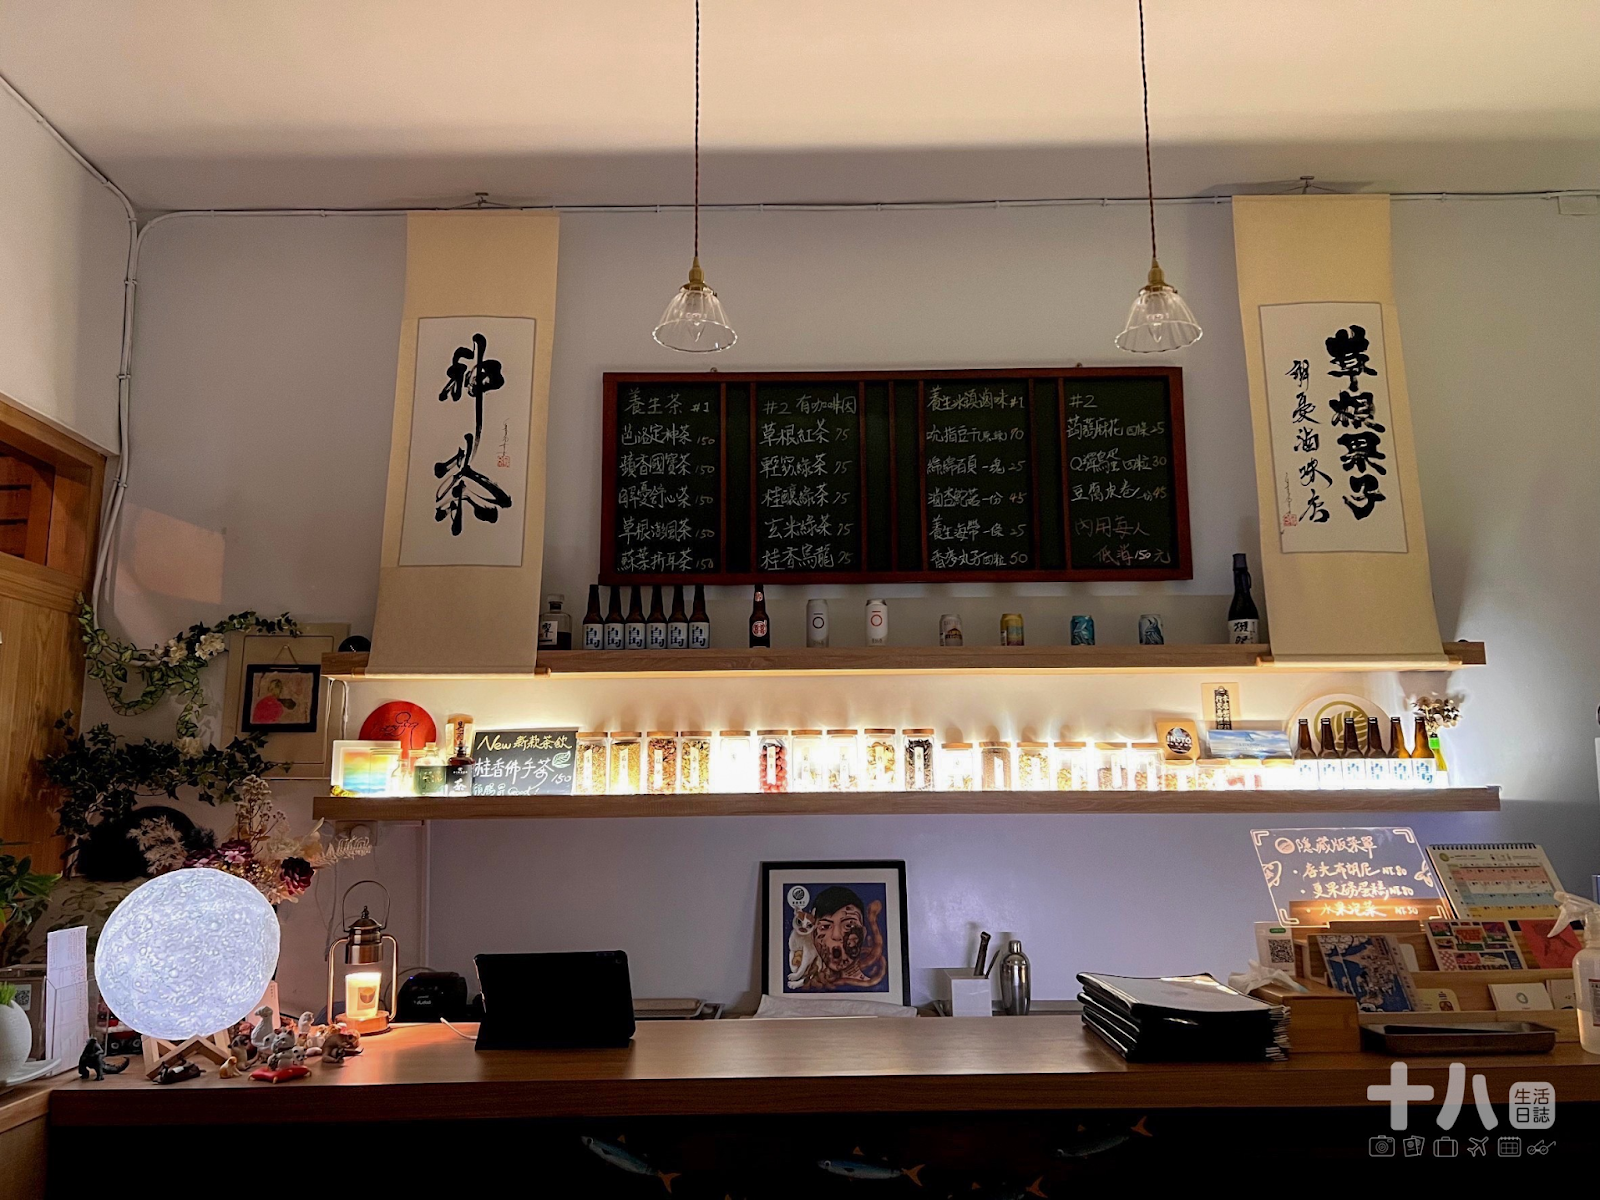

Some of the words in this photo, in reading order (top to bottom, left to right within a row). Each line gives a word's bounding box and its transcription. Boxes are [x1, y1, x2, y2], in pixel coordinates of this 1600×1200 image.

[624, 387, 682, 415] 養生茶
[690, 401, 710, 413] #1
[762, 400, 792, 415] #2
[796, 392, 857, 415] 有咖啡因
[1069, 393, 1098, 408] #2
[1325, 325, 1387, 521] 草根果子
[434, 333, 513, 536] 神茶
[759, 418, 830, 447] 草根紅茶
[835, 428, 850, 441] 75
[697, 436, 716, 446] 150
[619, 450, 691, 478] 蘋香國寶茶
[695, 465, 715, 475] 150
[833, 460, 853, 474] 75
[1008, 460, 1026, 472] 25
[1152, 455, 1167, 467] 30
[619, 480, 691, 509] 解憂舒心茶
[695, 495, 714, 506] 150
[832, 491, 850, 505] 75
[1009, 491, 1028, 504] 45
[1152, 486, 1167, 499] 45
[764, 513, 832, 539] 玄米綠茶
[837, 523, 855, 536] 75
[1010, 524, 1027, 538] 25
[695, 529, 715, 539] 150
[696, 558, 714, 570] 150
[760, 543, 834, 571] 桂香烏龍
[838, 550, 854, 564] 75
[1009, 551, 1028, 565] 50
[477, 735, 511, 751] New
[513, 735, 572, 751] 新款茶飲
[473, 757, 554, 787] 桂香佛手茶
[551, 774, 572, 785] 150
[1295, 836, 1377, 859] 隱藏版菜單
